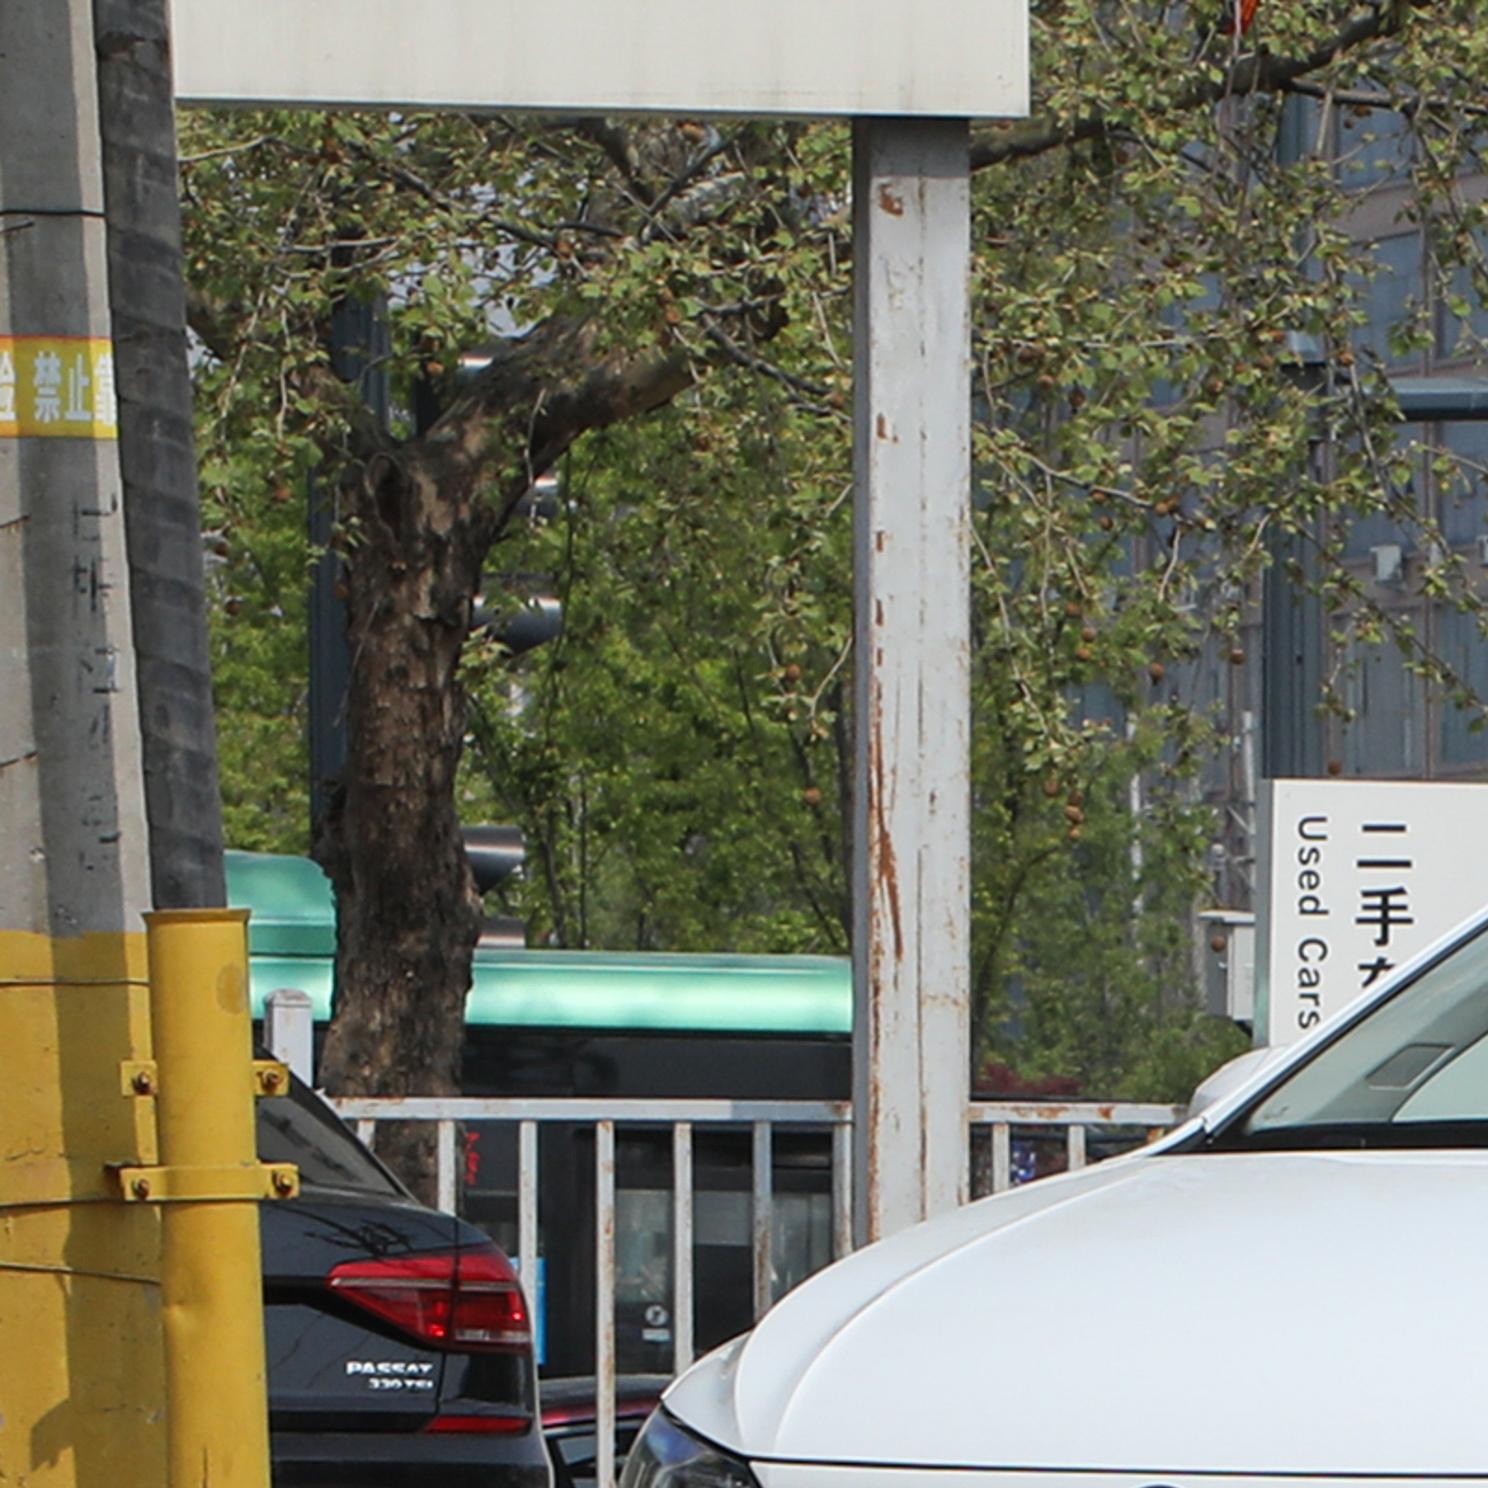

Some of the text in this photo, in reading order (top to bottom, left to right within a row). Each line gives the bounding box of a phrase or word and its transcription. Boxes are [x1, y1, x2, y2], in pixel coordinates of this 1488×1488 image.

[1297, 816, 1329, 1030] Used Cars
[345, 1361, 433, 1375] PASSAT
